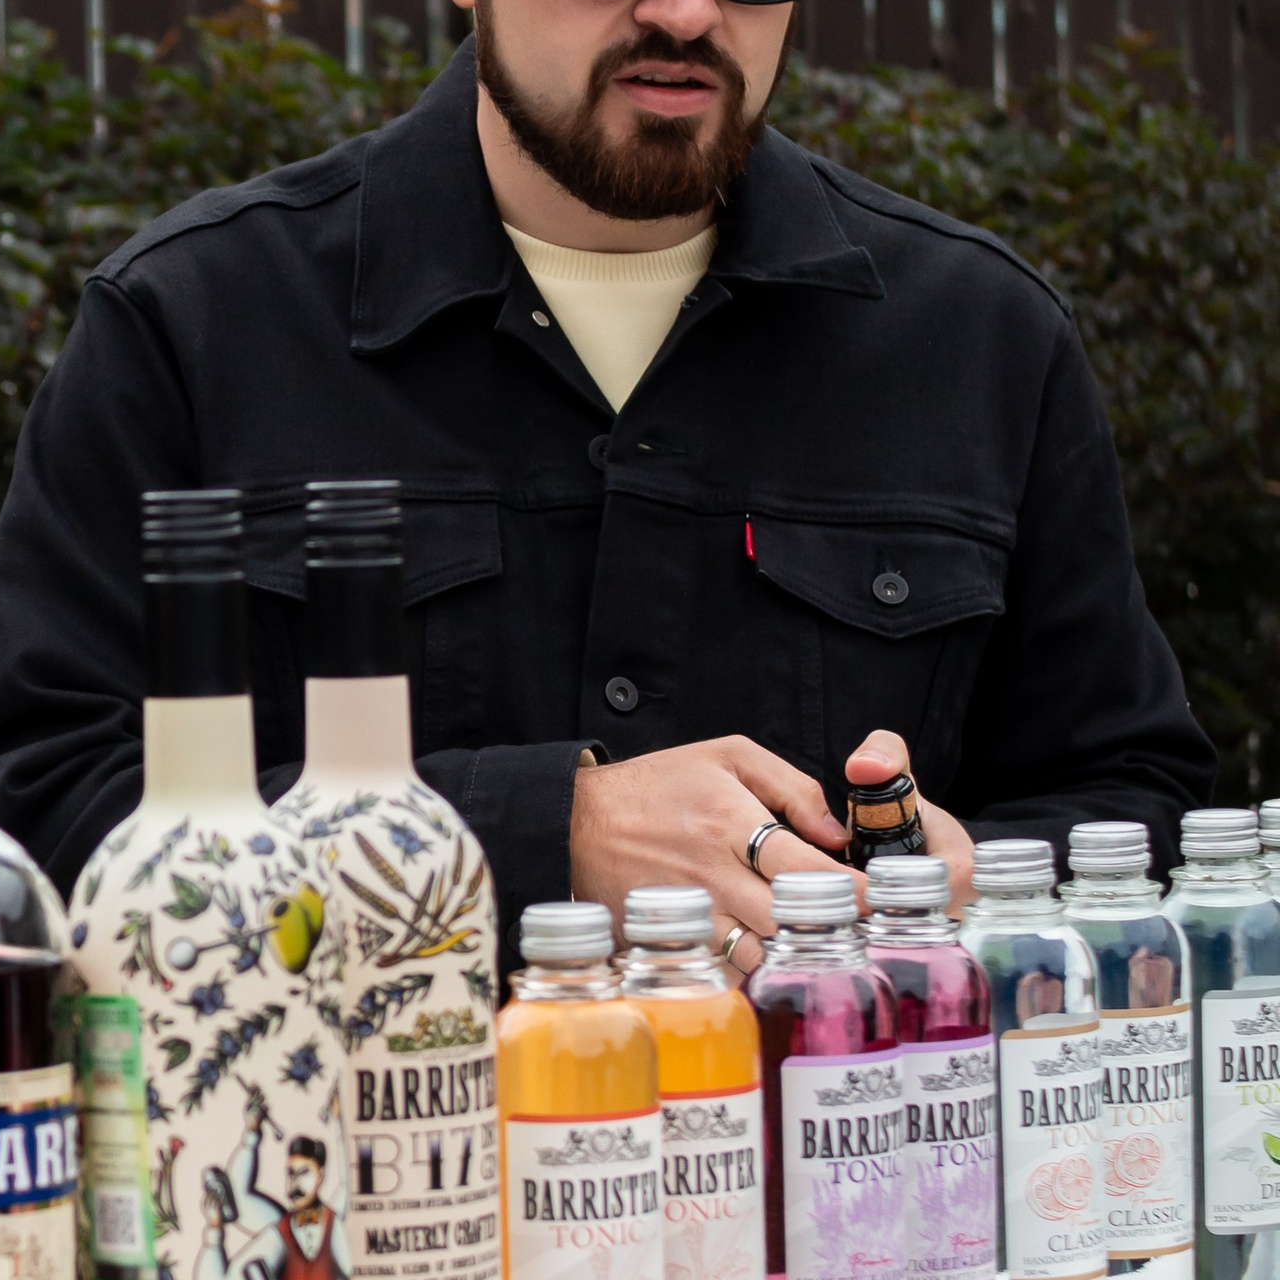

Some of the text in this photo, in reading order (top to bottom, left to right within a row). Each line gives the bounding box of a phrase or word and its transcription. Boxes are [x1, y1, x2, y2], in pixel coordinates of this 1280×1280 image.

[357, 1056, 496, 1121] BARRISTE
[1101, 1061, 1191, 1104] ARRISTE
[905, 1094, 995, 1143] BARRIST
[1107, 1100, 1184, 1127] TONIC
[799, 1108, 903, 1159] BARRIST
[522, 1170, 658, 1221] BARRISTER
[663, 1195, 741, 1223] ONIC
[1107, 1204, 1186, 1227] CLASSIC
[365, 1221, 449, 1254] MASTERLY
[548, 1220, 646, 1249] TONIC
[905, 1256, 960, 1271] IOLET
